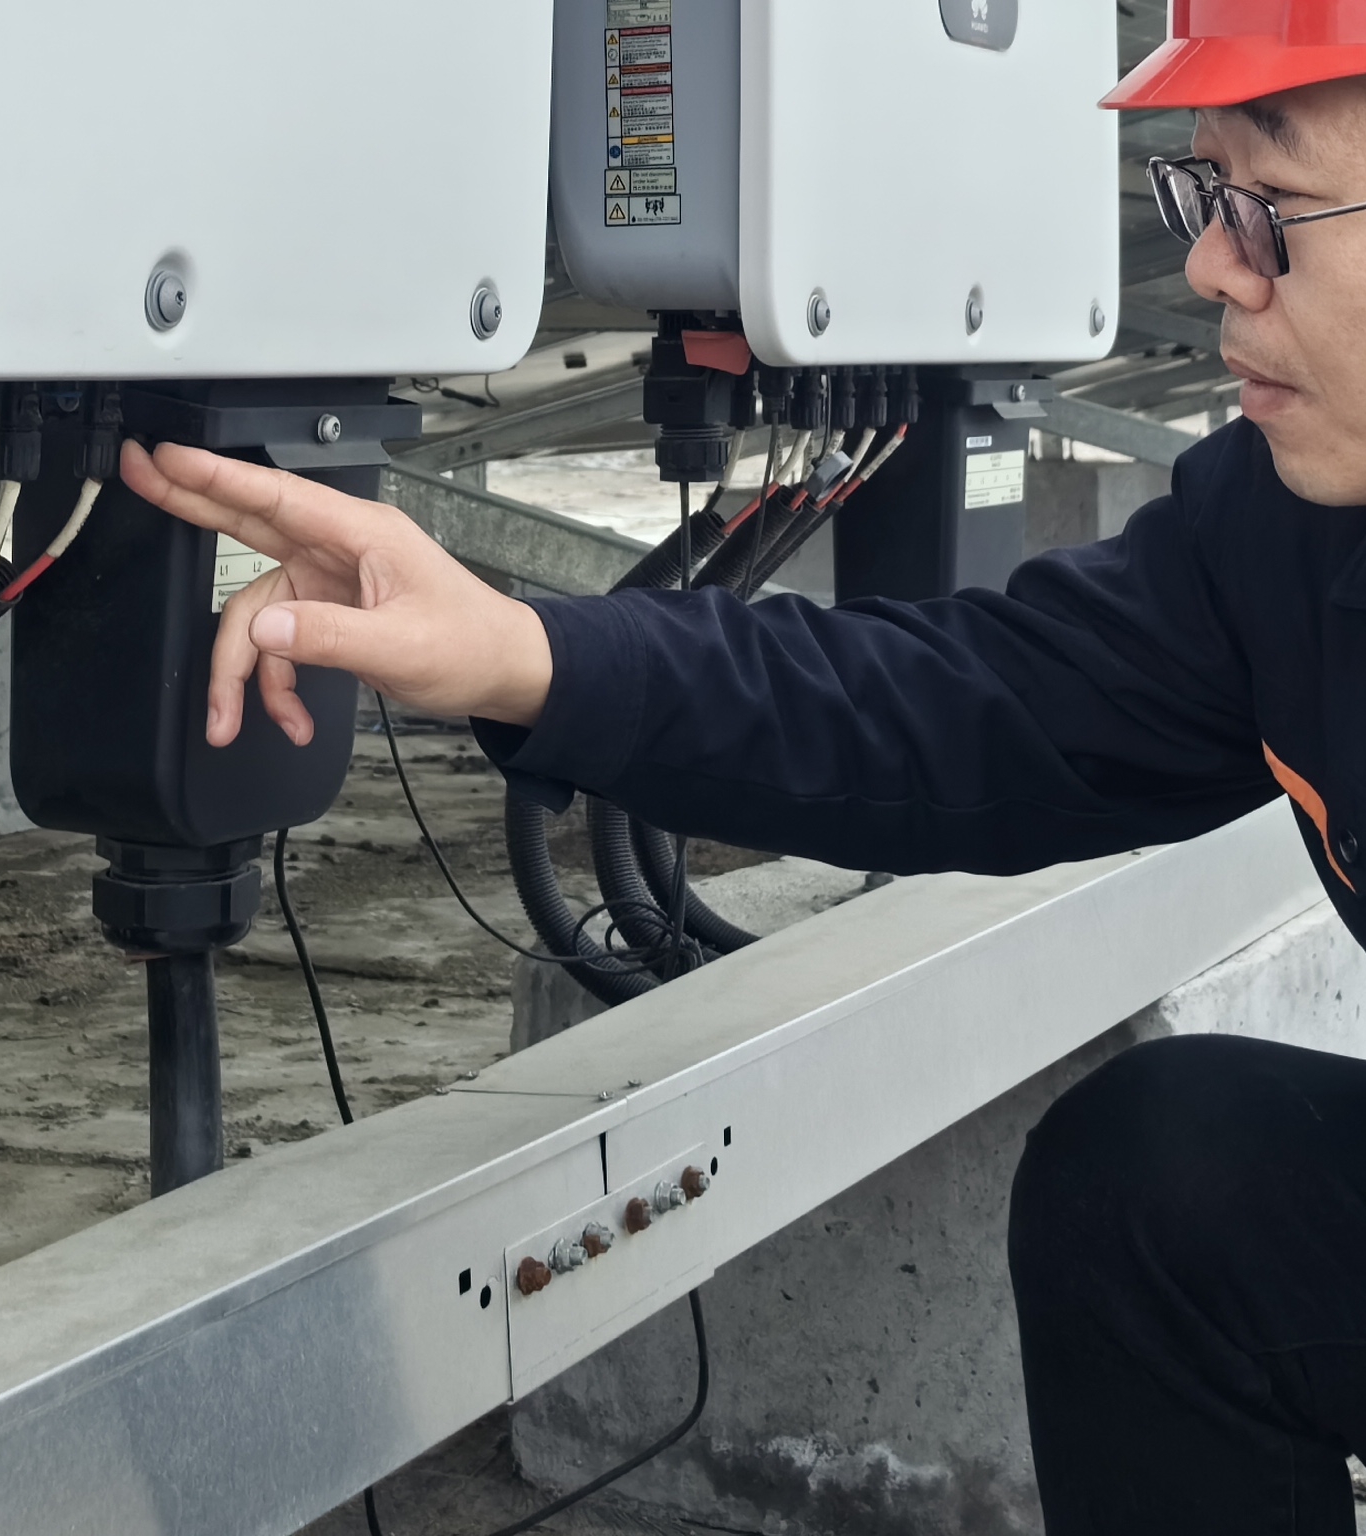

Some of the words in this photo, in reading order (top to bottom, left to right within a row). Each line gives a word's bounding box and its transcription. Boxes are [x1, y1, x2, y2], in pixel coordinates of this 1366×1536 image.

[971, 20, 989, 34] HUAWEI
[219, 564, 229, 577] L1
[253, 560, 263, 573] L2
